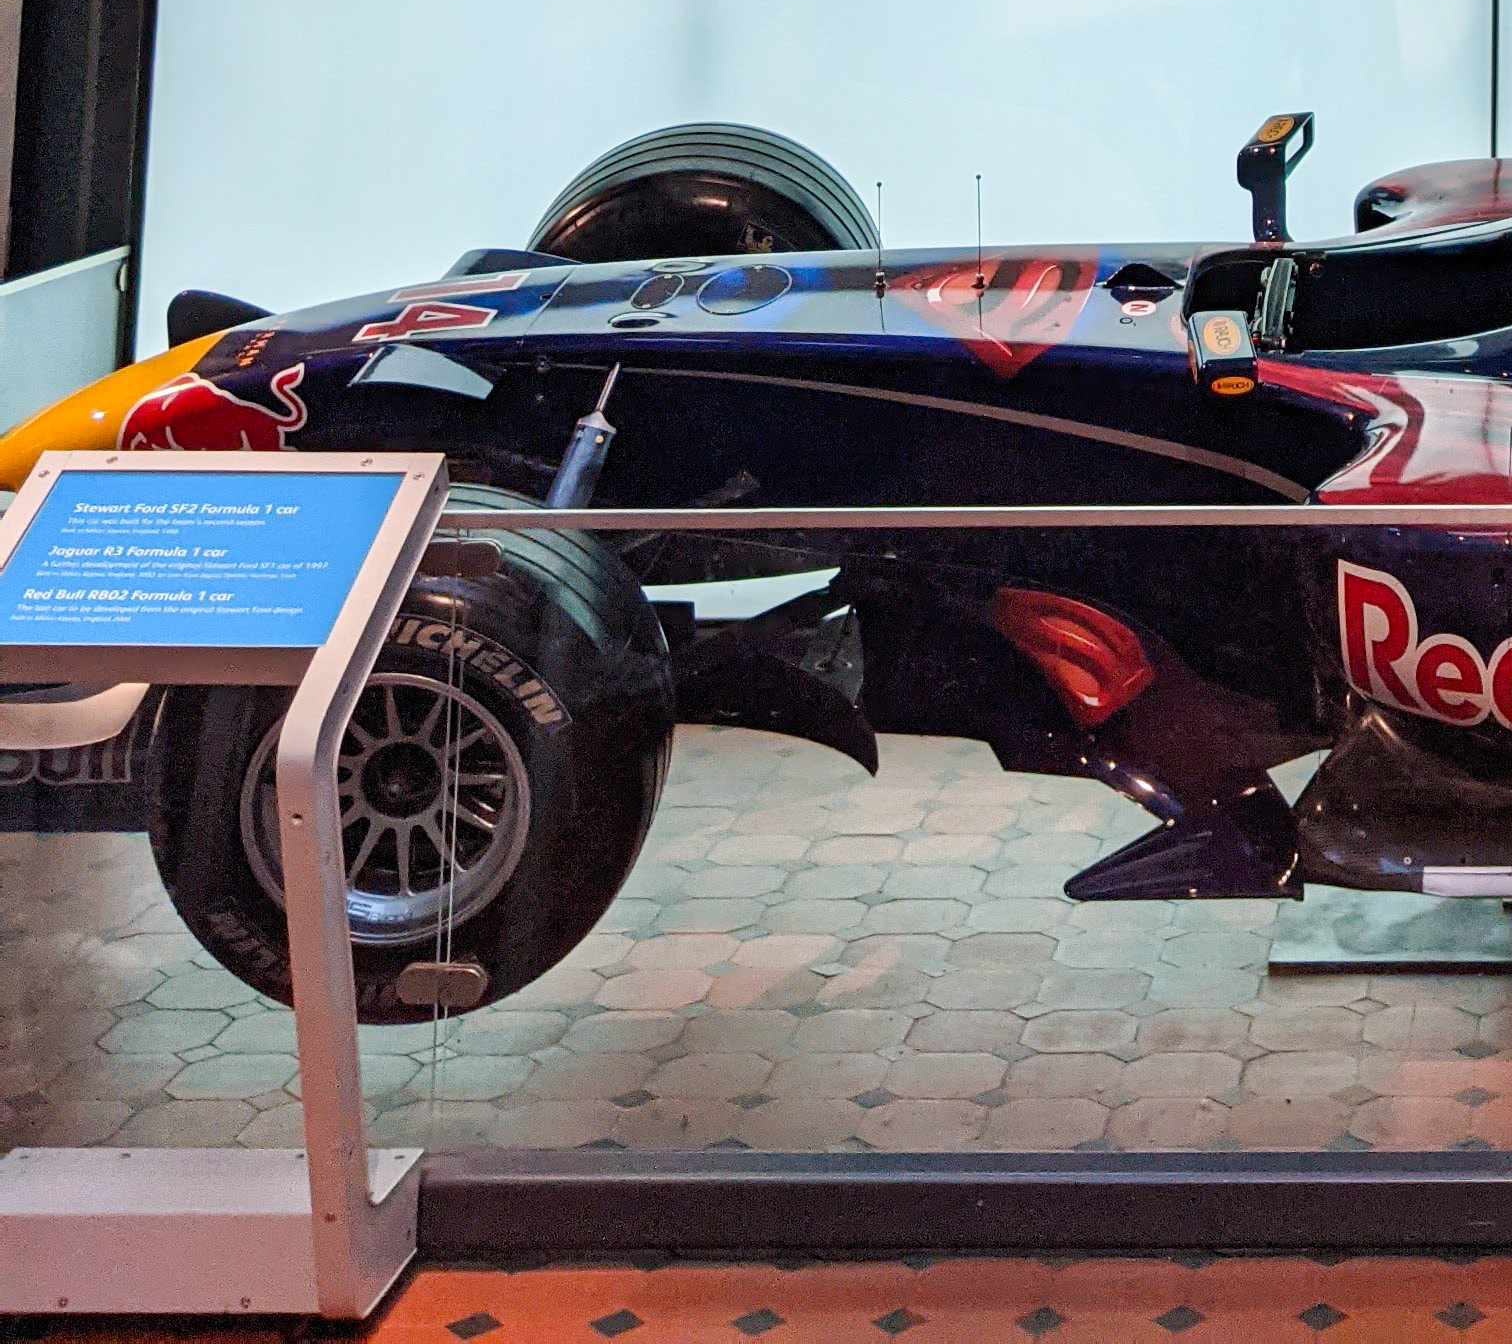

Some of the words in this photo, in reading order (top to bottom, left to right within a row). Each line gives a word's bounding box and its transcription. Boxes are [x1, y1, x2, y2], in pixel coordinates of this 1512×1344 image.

[73, 502, 131, 513] Stewart
[133, 503, 168, 514] Ford
[169, 503, 198, 514] SF2
[200, 503, 260, 515] Formula
[265, 504, 273, 515] 1
[276, 506, 301, 515] car
[48, 545, 101, 558] Jaguar
[102, 546, 125, 557] R3
[126, 546, 188, 557] Formula
[191, 546, 201, 558] 1
[203, 548, 229, 558] car
[23, 588, 54, 601] Red
[55, 589, 87, 601] Bull
[88, 589, 129, 601] RB02
[131, 589, 192, 602] Formula
[198, 590, 207, 602] 1
[209, 592, 235, 602] car
[389, 615, 564, 726] ICHELIN
